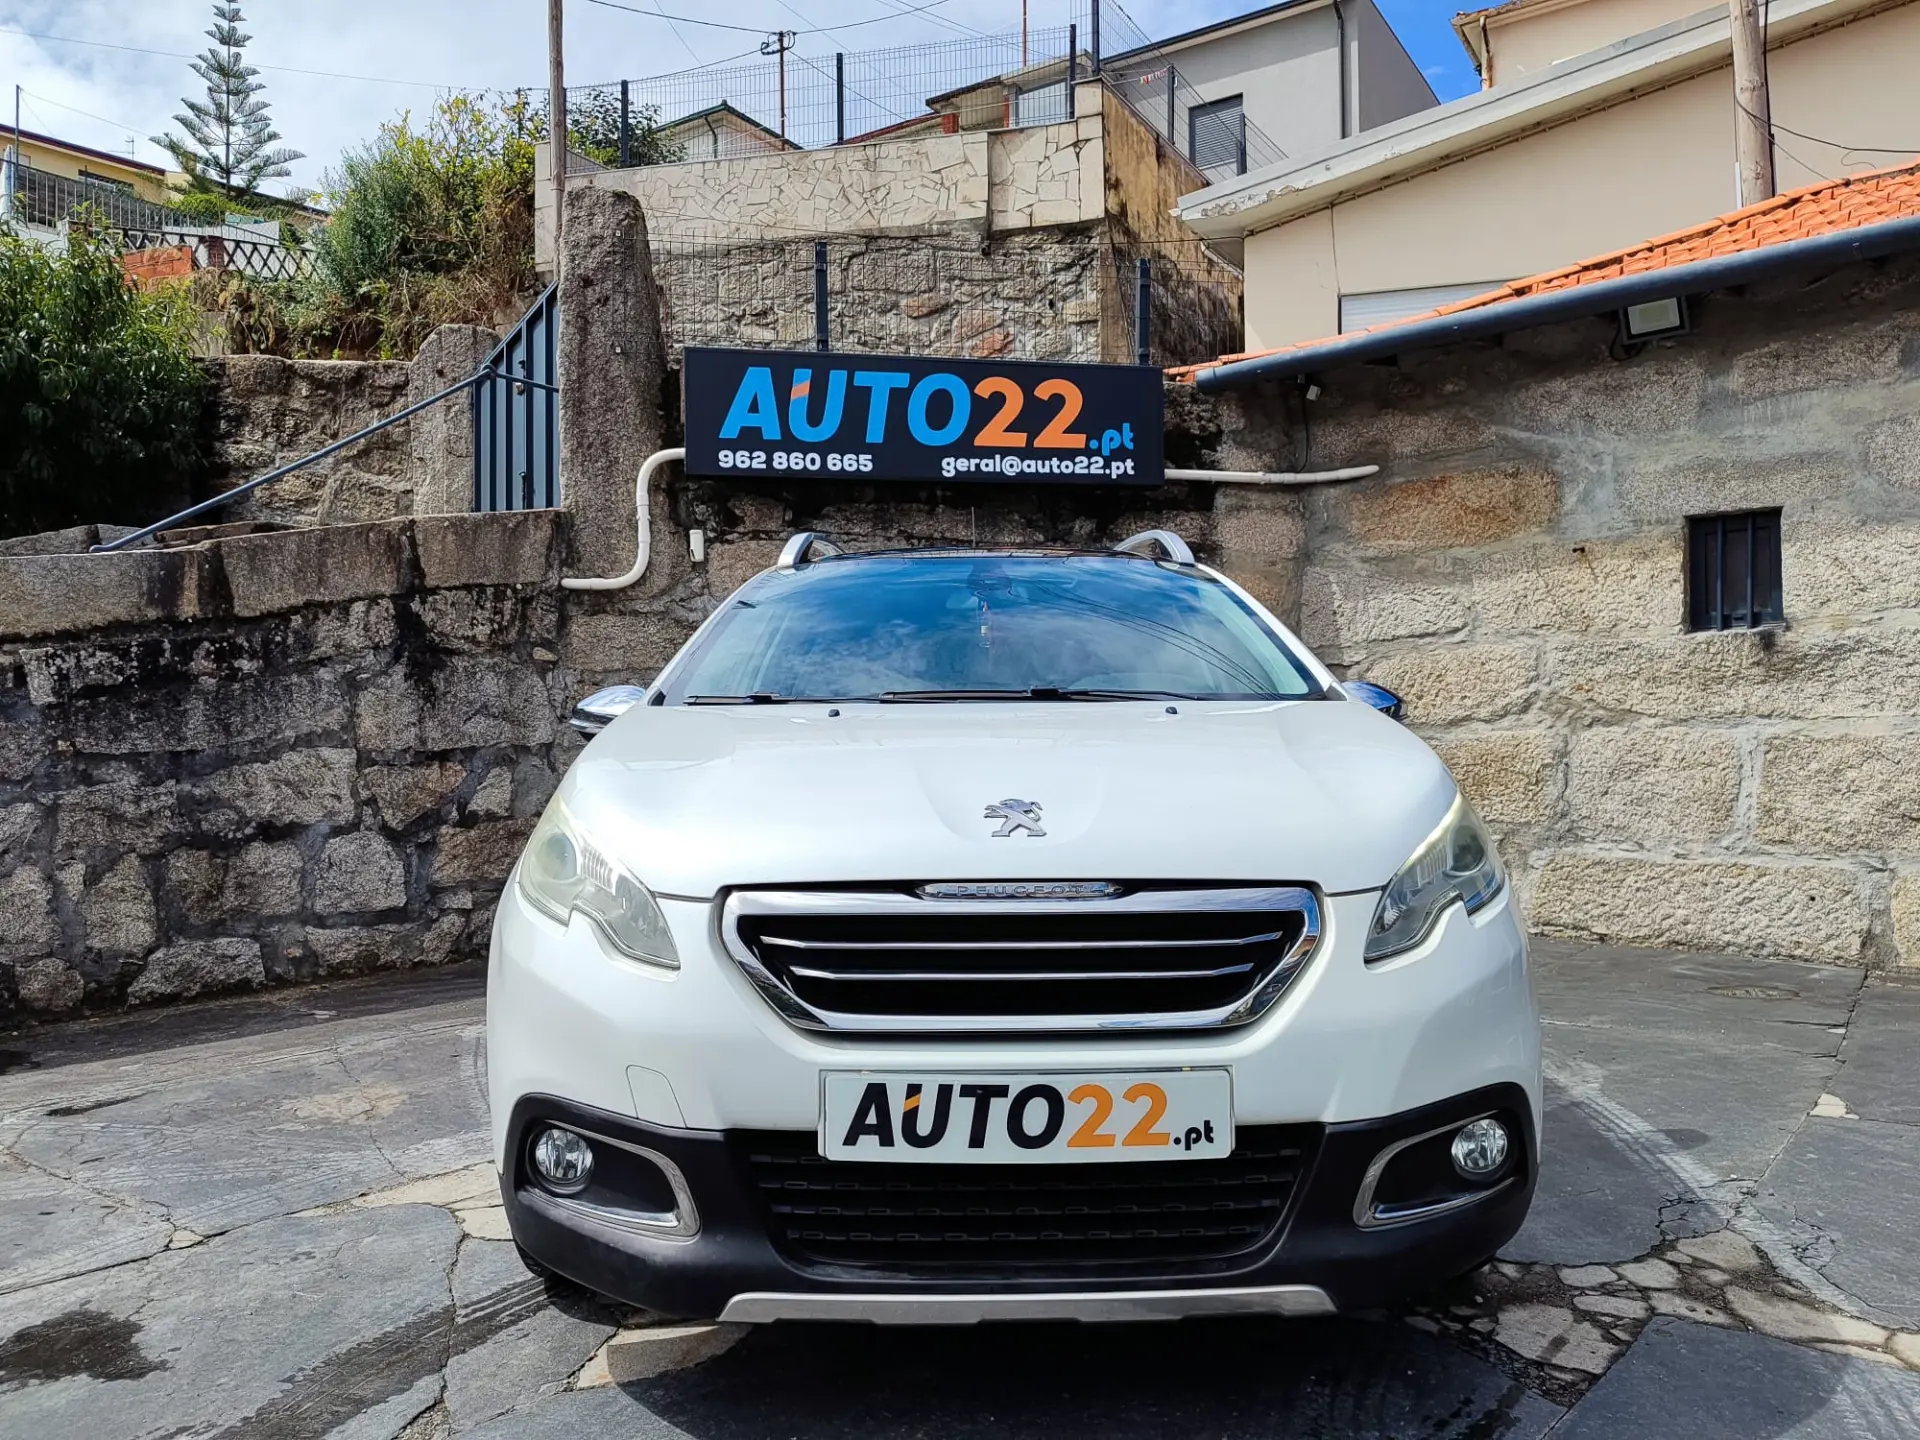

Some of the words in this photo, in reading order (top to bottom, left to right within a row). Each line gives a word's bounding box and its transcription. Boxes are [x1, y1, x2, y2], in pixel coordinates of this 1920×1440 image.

[718, 366, 1135, 456] AUTO22.pt
[718, 450, 767, 470] 962
[772, 451, 821, 472] 860
[826, 453, 873, 473] 665
[941, 454, 1135, 479] geral@auto22.pt
[956, 884, 1084, 897] PEUGEOT
[842, 1082, 1215, 1151] AUTO22.pt
